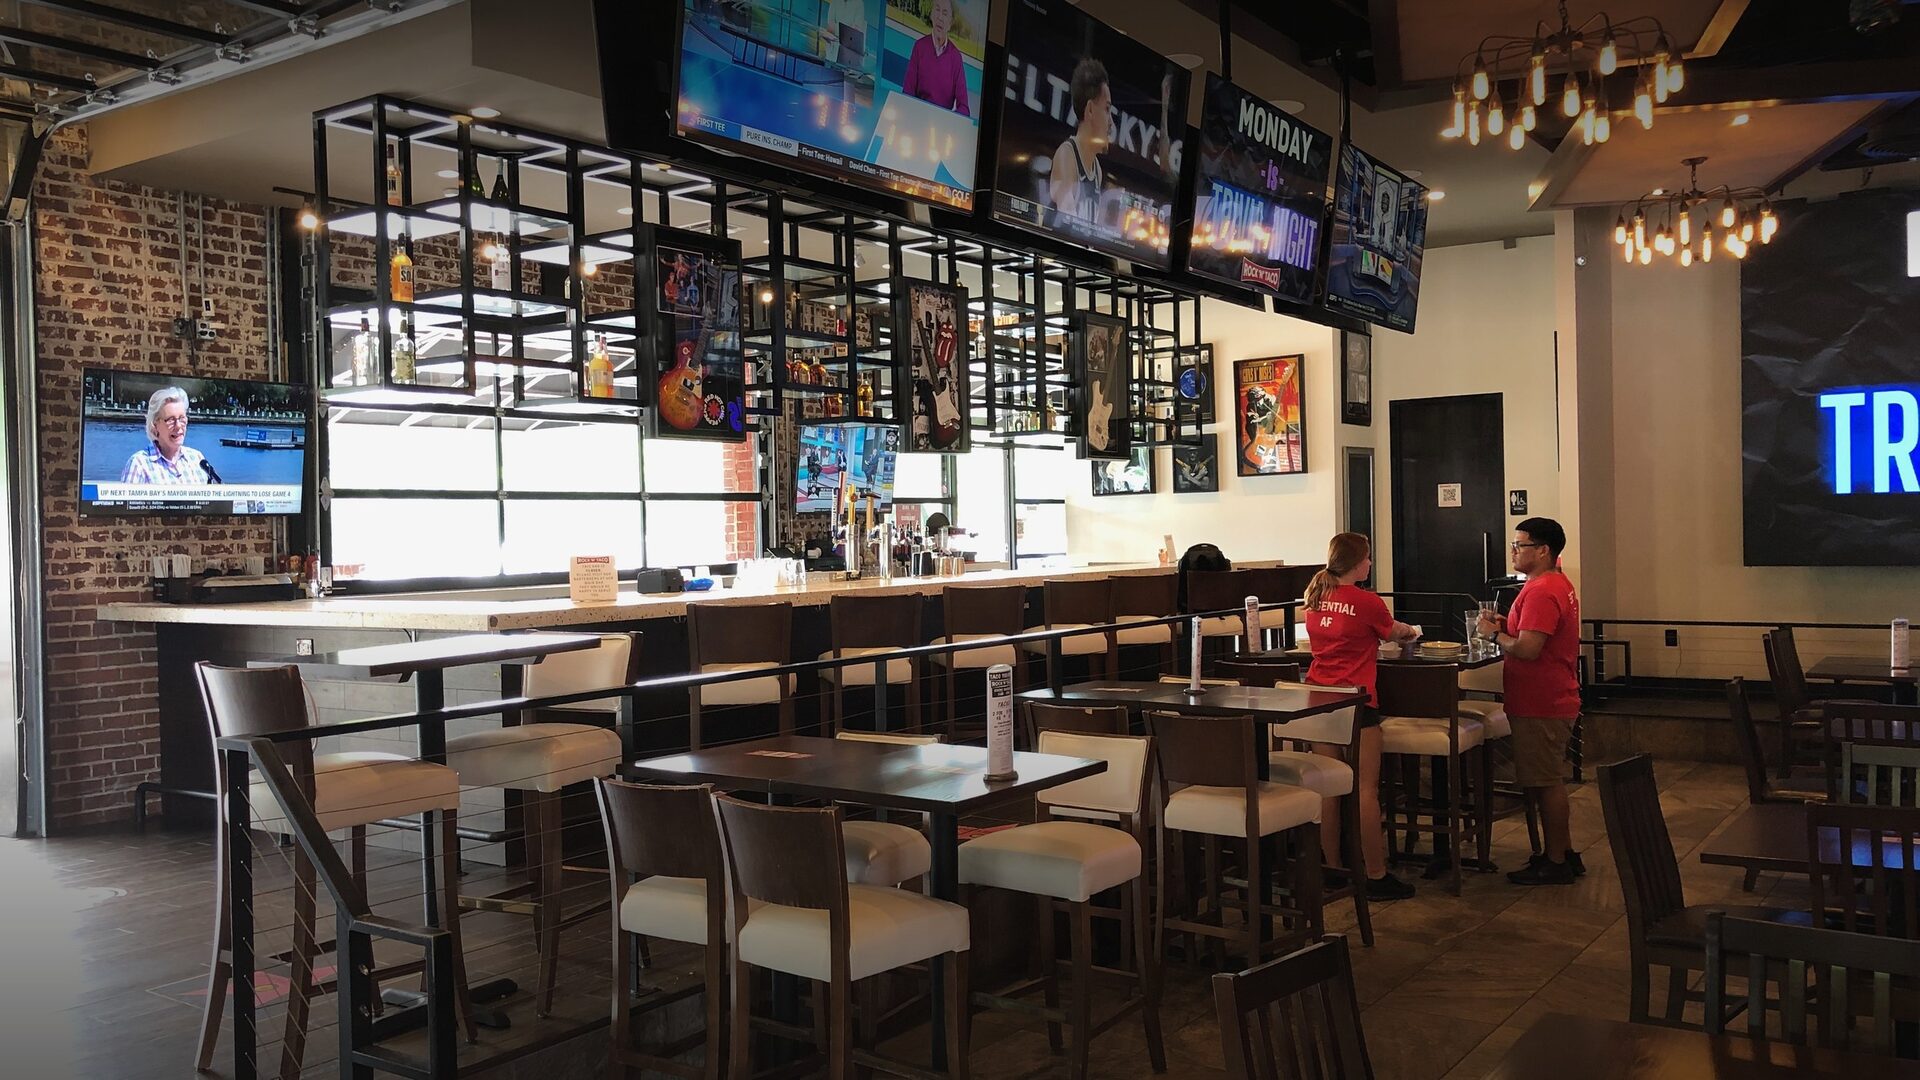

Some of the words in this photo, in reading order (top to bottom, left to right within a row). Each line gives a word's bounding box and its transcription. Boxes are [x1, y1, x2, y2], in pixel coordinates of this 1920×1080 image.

[697, 117, 714, 129] FIRST
[715, 122, 726, 132] TEE
[1239, 98, 1313, 164] MONDAY
[746, 130, 760, 141] PURE
[802, 147, 813, 158] First
[826, 153, 843, 166] Hawaii
[849, 160, 864, 172] David
[952, 188, 971, 203] GOLF
[1267, 205, 1318, 271] NIGHT
[1243, 263, 1258, 278] ROCK
[1265, 271, 1278, 285] TACO
[1320, 617, 1333, 627] AF
